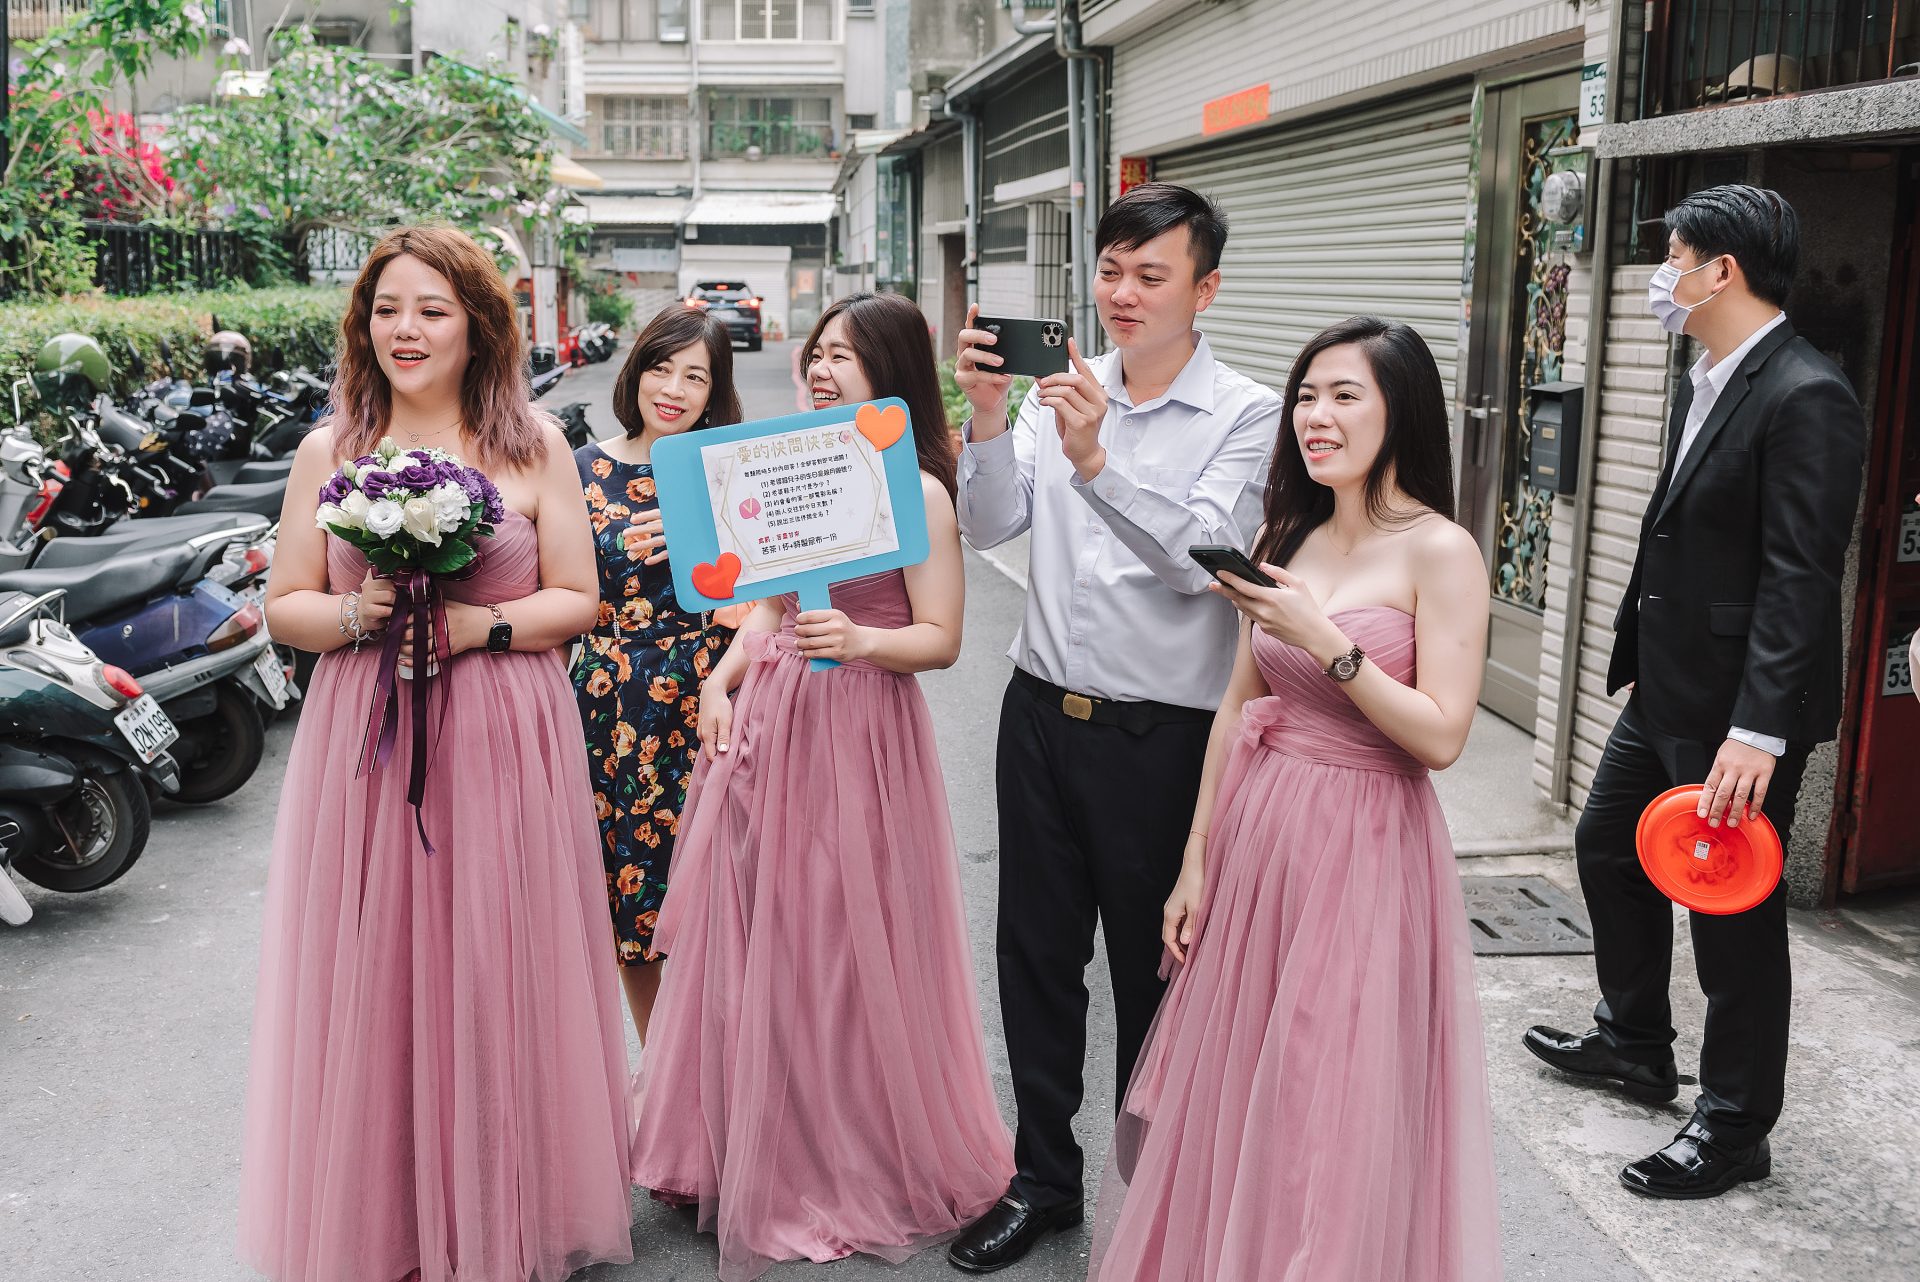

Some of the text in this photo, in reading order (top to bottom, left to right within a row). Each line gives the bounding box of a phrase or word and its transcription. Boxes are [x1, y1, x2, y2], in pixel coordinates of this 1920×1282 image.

[1590, 94, 1605, 117] 53
[737, 432, 837, 464] 愛的快問快答
[1887, 662, 1910, 688] 53
